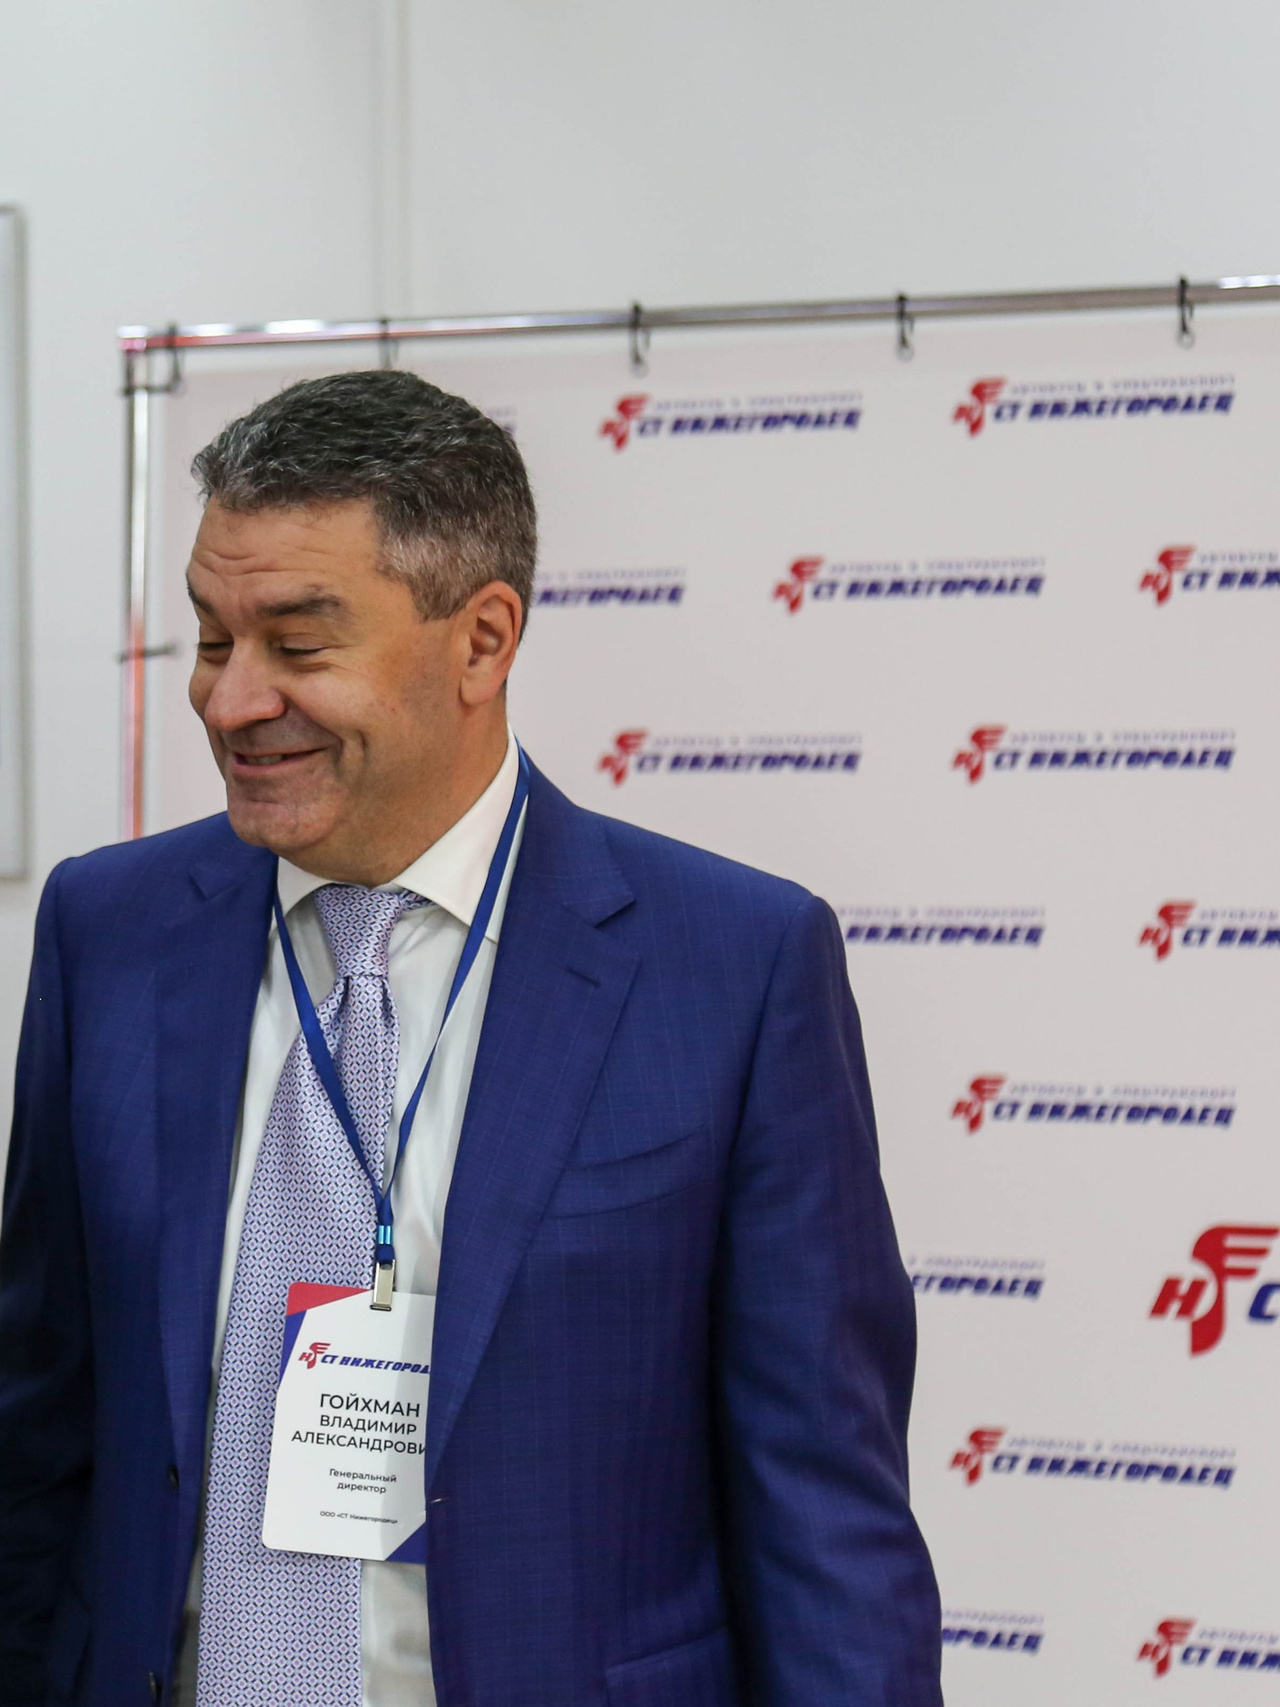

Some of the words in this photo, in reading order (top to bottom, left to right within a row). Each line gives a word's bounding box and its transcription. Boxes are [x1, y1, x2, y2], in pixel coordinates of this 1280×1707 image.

[320, 1354, 340, 1364] СТ
[339, 1356, 431, 1375] НИЖЕГОРОД
[320, 1392, 420, 1418] ГОЙХМАН
[320, 1414, 417, 1435] ВЛАДИМИР
[291, 1430, 427, 1455] АЛЕКСАНДРОВИ
[329, 1468, 397, 1482] Генеральный
[337, 1482, 387, 1494] директор
